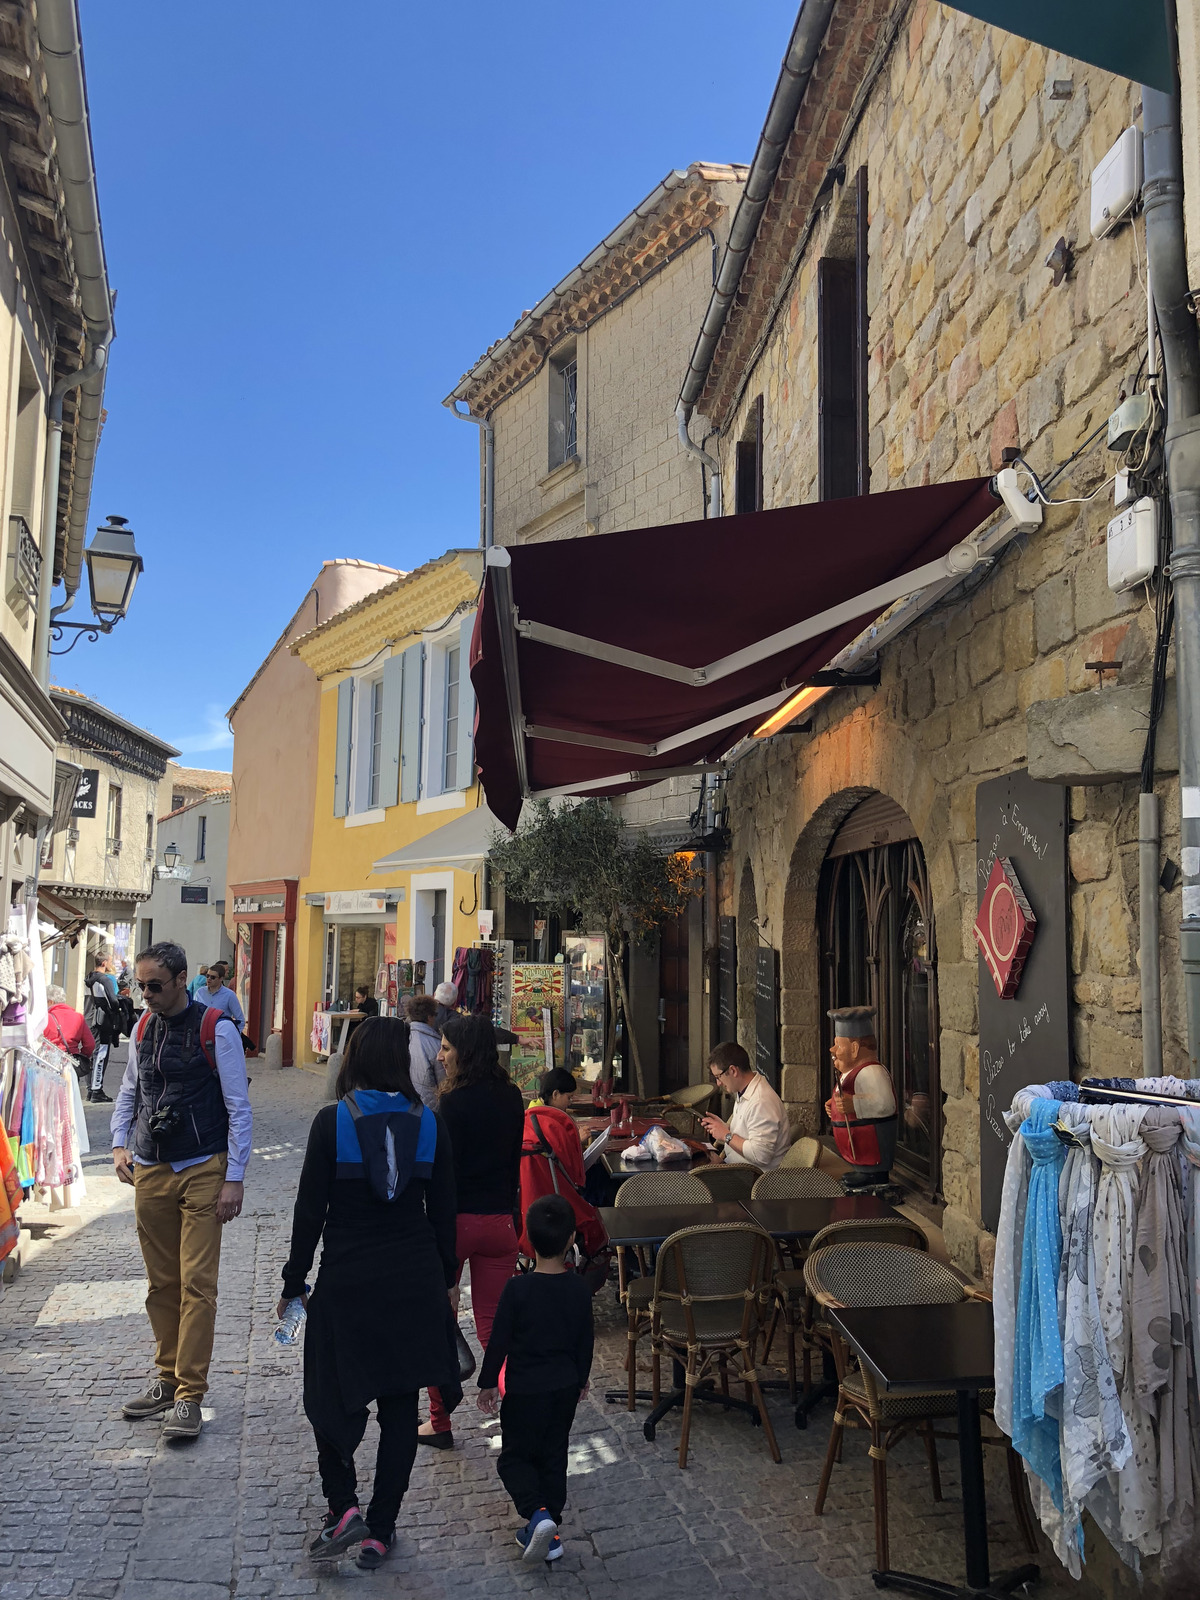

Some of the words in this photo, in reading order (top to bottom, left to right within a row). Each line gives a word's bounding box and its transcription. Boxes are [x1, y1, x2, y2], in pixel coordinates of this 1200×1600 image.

[1007, 1038, 1016, 1058] to
[1018, 1016, 1032, 1044] take
[1034, 1002, 1051, 1024] away
